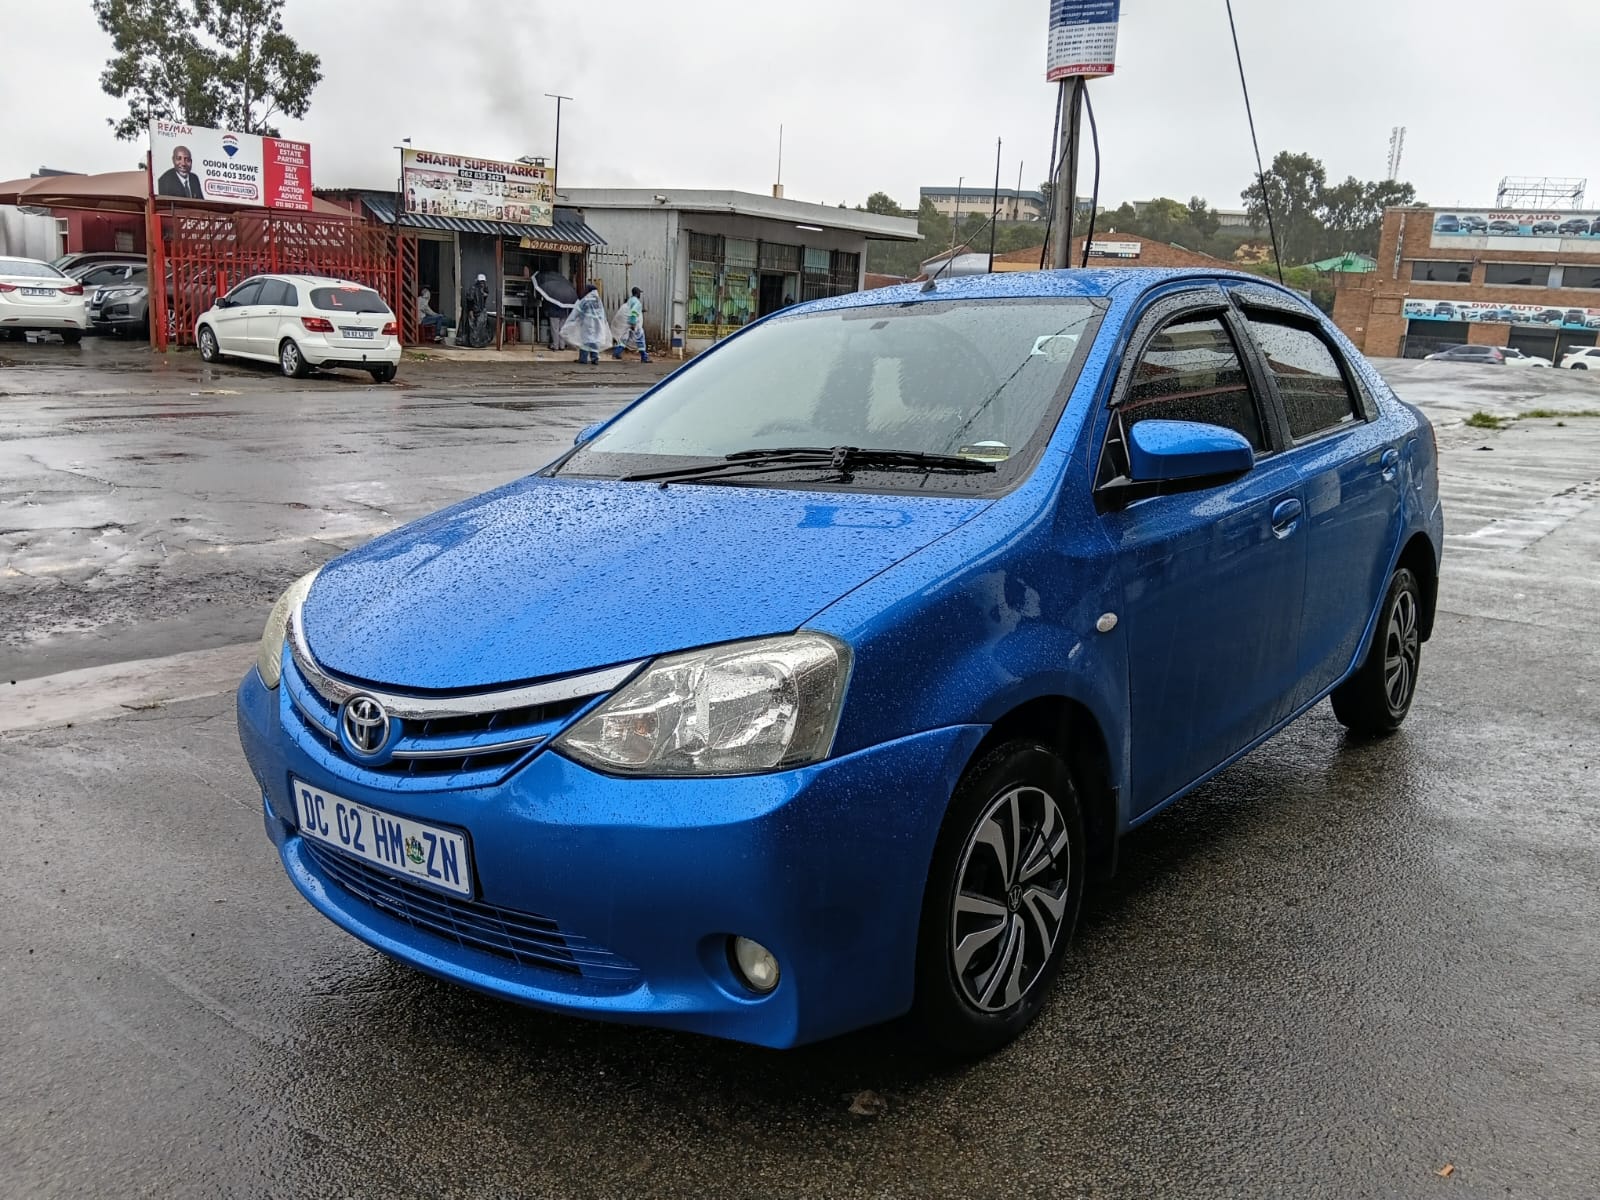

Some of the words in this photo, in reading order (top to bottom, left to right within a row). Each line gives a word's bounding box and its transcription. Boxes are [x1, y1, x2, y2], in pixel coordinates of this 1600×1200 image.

[158, 123, 193, 135] RE/MAX
[158, 130, 177, 138] FINEST
[274, 142, 290, 150] YOUR
[292, 144, 306, 152] REAL
[280, 150, 302, 158] ESTATE
[276, 156, 304, 164] PARTNER
[203, 160, 228, 170] ODION
[230, 163, 259, 173] OSIGWE
[416, 152, 461, 168] SHAFIN
[464, 160, 546, 179] SUPERMARKET
[222, 170, 237, 179] 403
[238, 173, 256, 182] 3506
[278, 186, 304, 194] AUCTION
[280, 192, 302, 201] ADVICE
[538, 241, 558, 250] FAST
[331, 294, 343, 306] L
[1508, 304, 1543, 312] AUTO
[302, 790, 328, 836] DC
[336, 802, 365, 852] 02
[372, 815, 406, 867] HM
[422, 831, 460, 885] ZN
